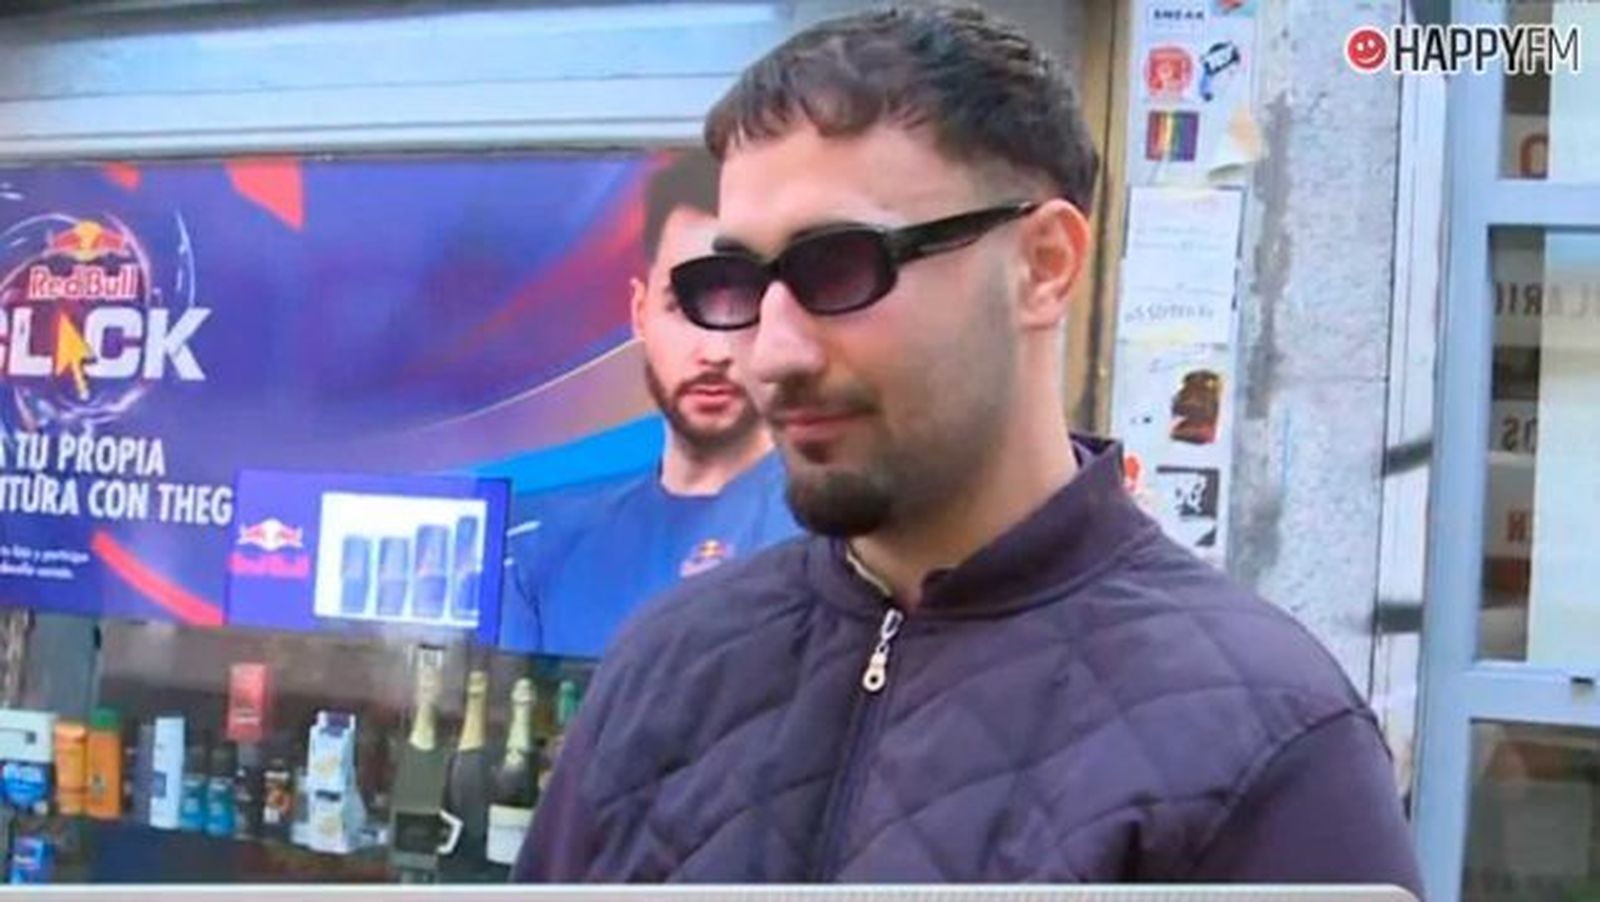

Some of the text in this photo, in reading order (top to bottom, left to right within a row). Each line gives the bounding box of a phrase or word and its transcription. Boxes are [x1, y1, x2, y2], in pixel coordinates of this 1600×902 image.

[28, 263, 139, 300] Red Bull
[15, 433, 49, 470] TU
[57, 435, 166, 476] PROPIA
[0, 476, 233, 525] TURA CON THEG
